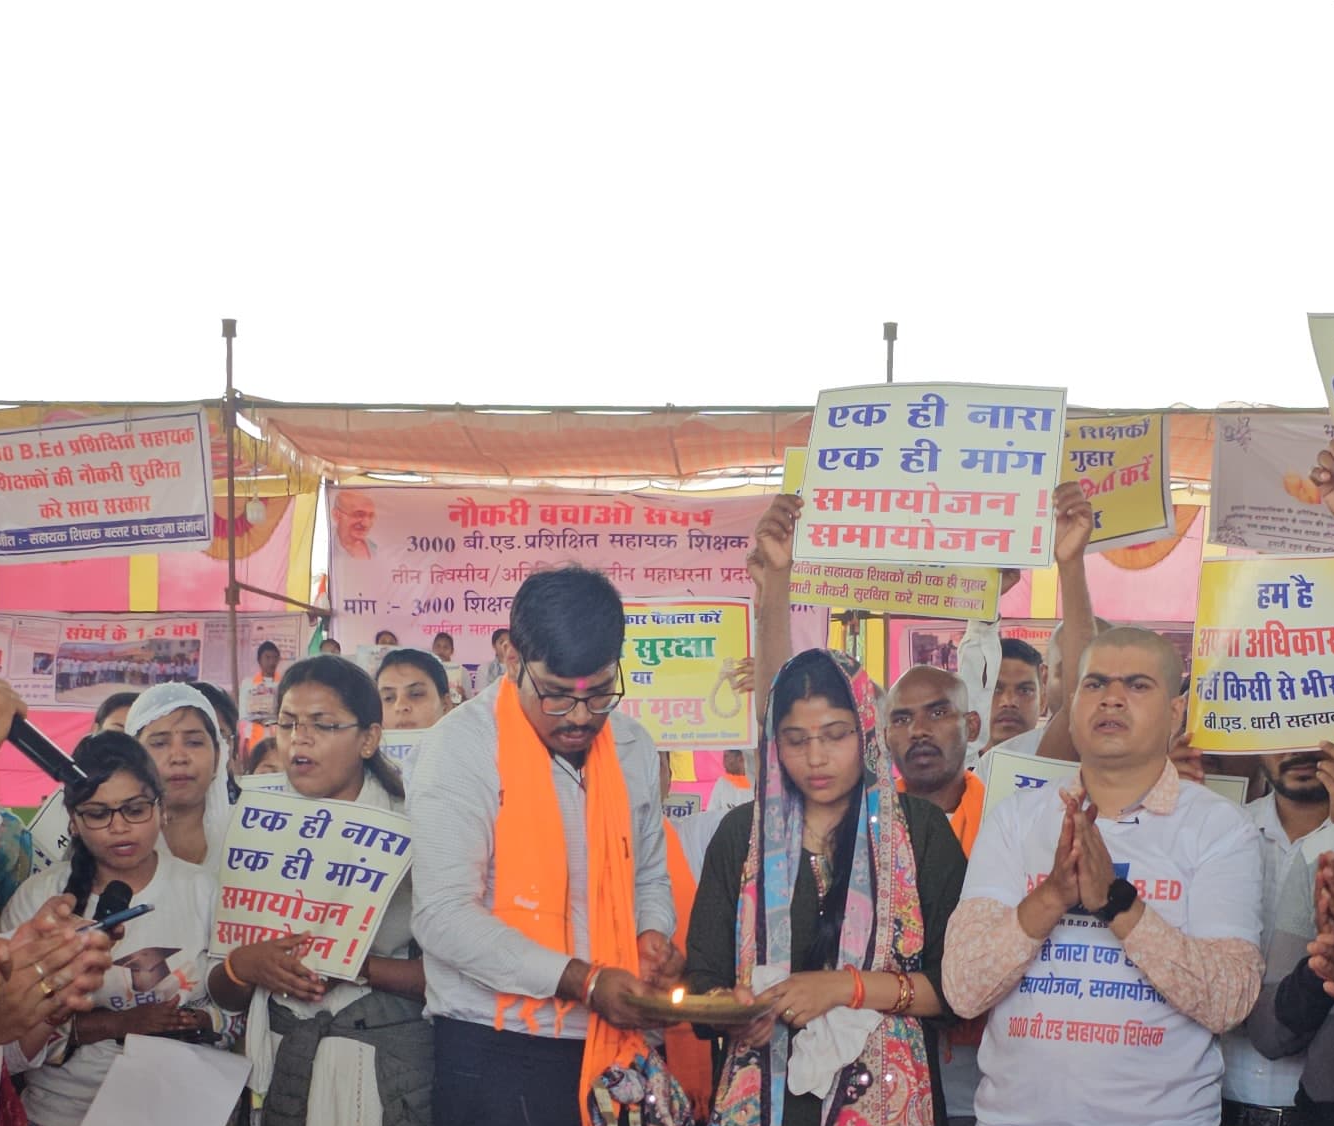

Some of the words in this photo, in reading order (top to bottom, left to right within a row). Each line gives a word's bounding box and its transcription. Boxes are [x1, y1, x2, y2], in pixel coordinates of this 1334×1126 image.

[827, 403, 892, 428] एक
[906, 392, 949, 429] ही
[966, 404, 1056, 432] नारा
[19, 439, 65, 460] B.Ed
[68, 430, 136, 456] प्रशिक्षित
[139, 427, 195, 448] सहायक
[817, 447, 884, 471] एक
[899, 437, 942, 473] ही
[959, 440, 1047, 476] मांग
[53, 465, 74, 488] की
[77, 461, 124, 485] नौकरी
[128, 458, 182, 488] सुरक्षित
[1069, 450, 1116, 473] गुहार
[1119, 454, 1154, 487] करें
[66, 498, 99, 518] साय
[104, 495, 151, 514] सरकार
[447, 496, 531, 528] नौकरी
[539, 500, 636, 526] बचाओ
[812, 481, 1021, 517] समायोजन
[28, 531, 67, 545] सहायक
[406, 535, 457, 554] 3000
[609, 533, 678, 551] सहायक
[687, 527, 750, 552] शिक्षक
[807, 518, 1016, 553] समायोजन
[391, 563, 423, 585] तीन
[643, 566, 712, 584] महाधरना
[791, 560, 821, 577] यनित
[824, 564, 864, 580] सहायक
[866, 565, 905, 584] शिक्षकों
[907, 570, 923, 586] की
[925, 574, 943, 588] एक
[343, 592, 377, 615] मांग
[788, 579, 812, 595] मारी
[815, 582, 849, 599] नौकरी
[917, 593, 939, 607] साय
[1256, 583, 1290, 609] हम
[1290, 574, 1315, 609] है
[65, 621, 106, 641] संघर्ष
[111, 624, 128, 641] के
[697, 610, 723, 624] करें
[632, 636, 717, 667] सुरक्षा
[630, 671, 654, 685] या
[1223, 671, 1271, 702] किसी
[1277, 671, 1296, 701] से
[647, 697, 707, 726] मृत्यु
[1203, 711, 1247, 733] बी.एड.
[1251, 713, 1281, 730] धारी
[241, 806, 292, 832] एक
[298, 808, 333, 839] ही
[341, 820, 411, 857] नारा
[227, 847, 274, 872] एक
[280, 847, 315, 880] ही
[325, 857, 388, 893] मांग
[222, 886, 354, 927] समायोजन
[1054, 943, 1090, 962] नारा
[1092, 944, 1122, 965] एक
[1029, 1012, 1065, 1041] बी.एड
[1066, 1020, 1121, 1044] सहायक
[1123, 1018, 1166, 1047] शिक्षक
